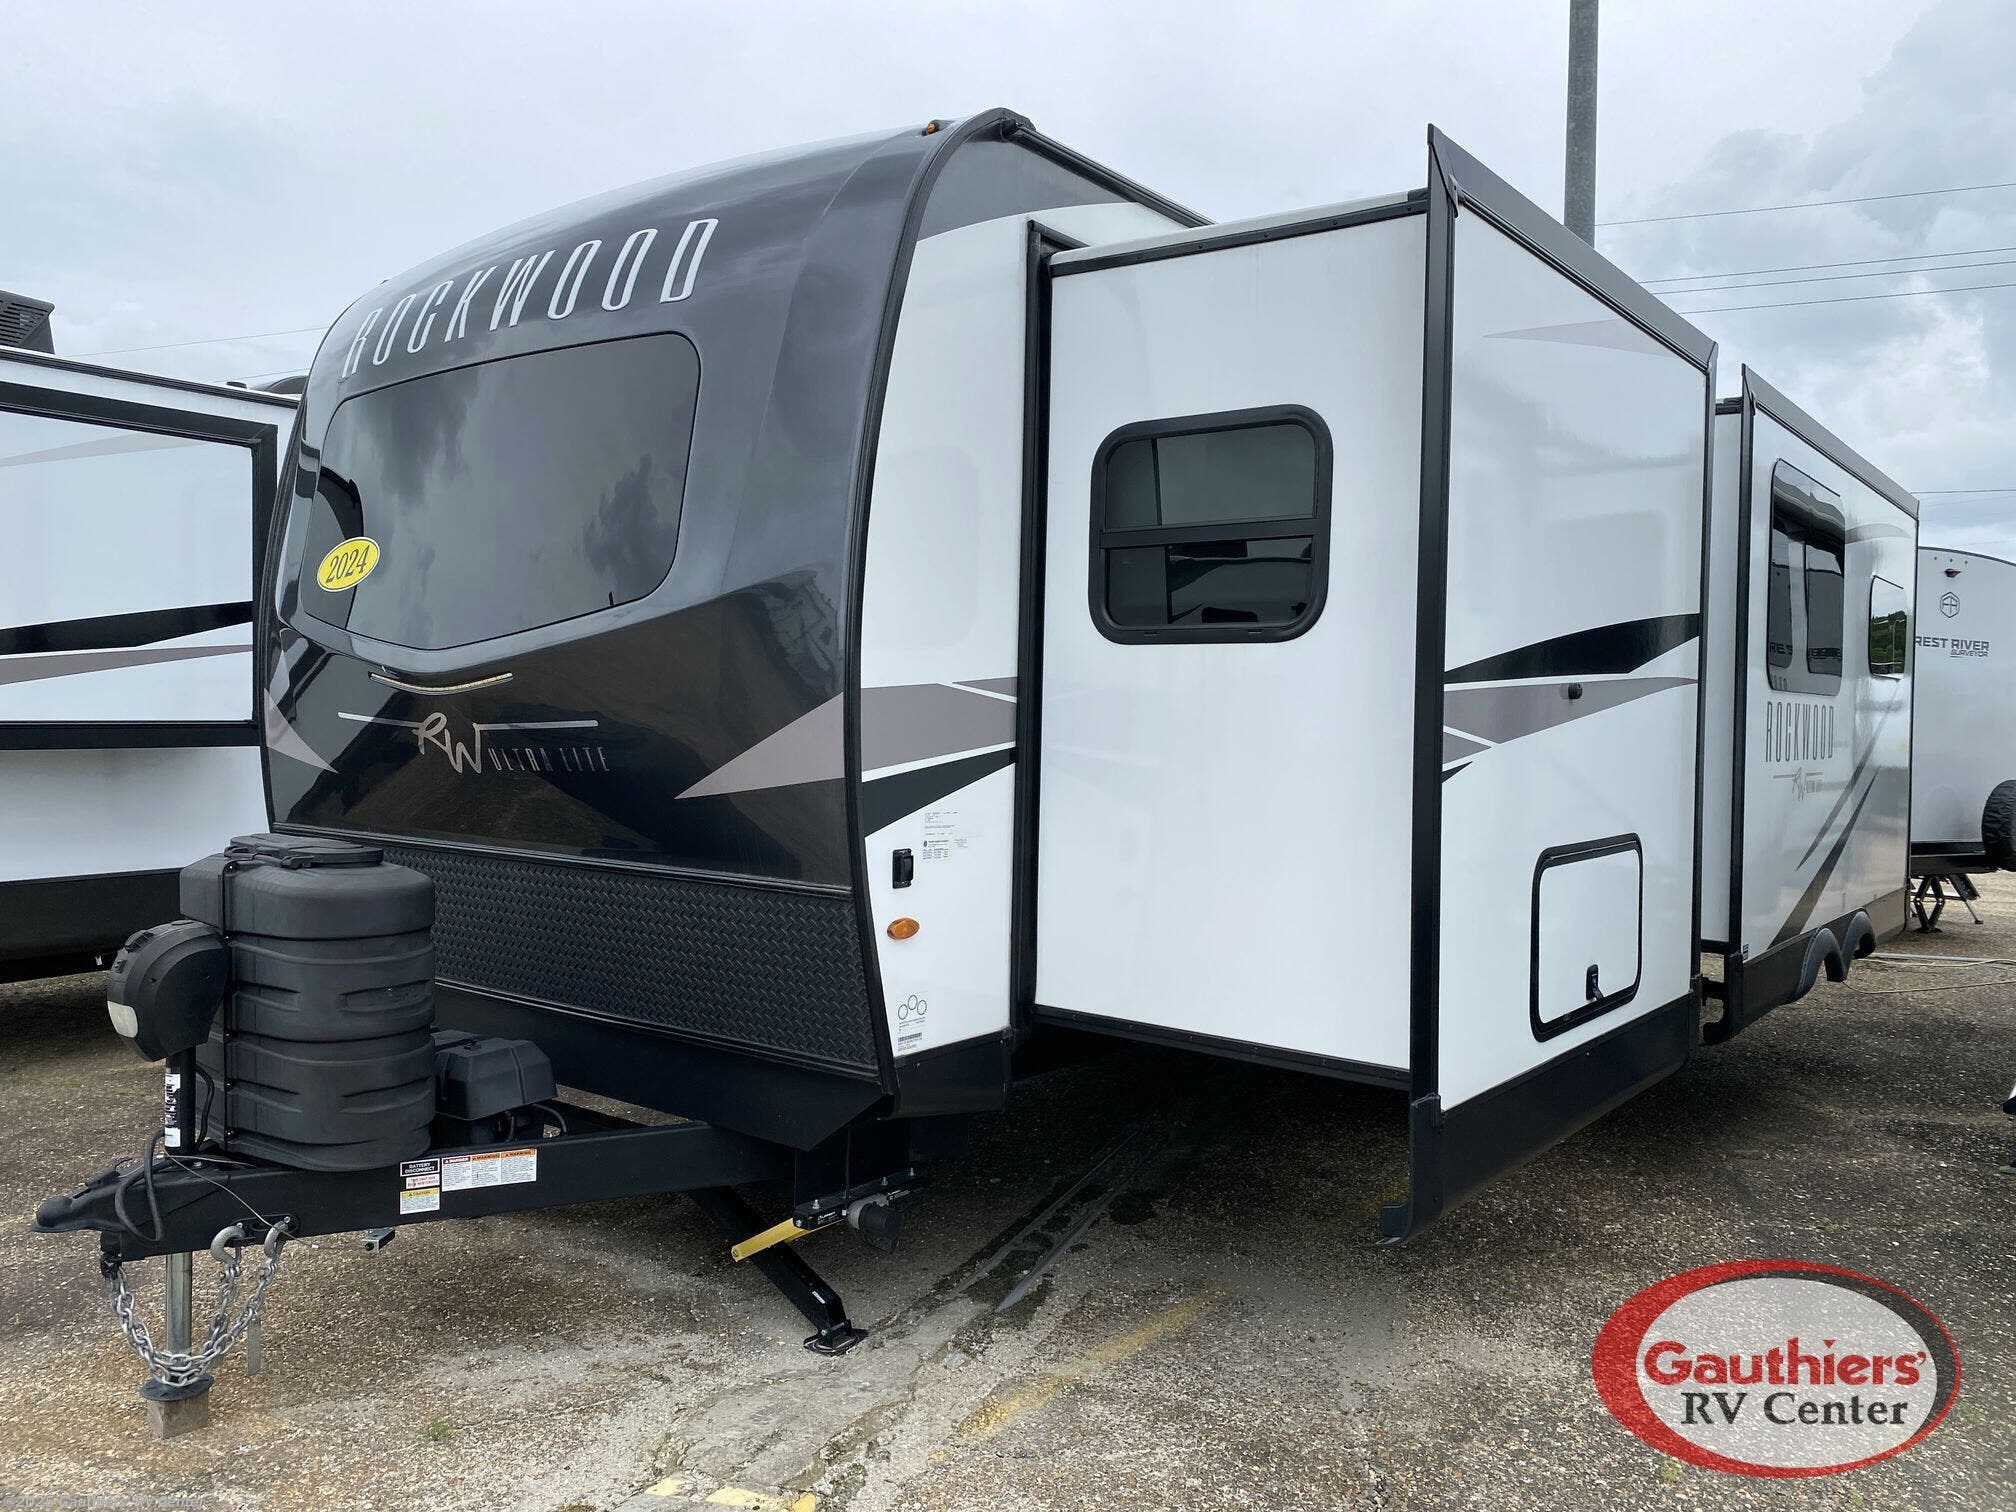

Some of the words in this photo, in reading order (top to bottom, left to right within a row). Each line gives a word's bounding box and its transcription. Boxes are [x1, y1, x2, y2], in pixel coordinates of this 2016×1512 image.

[340, 218, 719, 380] ROCKWOOD
[325, 545, 371, 583] 2024
[1951, 639, 1990, 651] RIVER
[1951, 649, 1988, 657] SURVEYOR
[411, 712, 482, 774] RW
[1766, 701, 1834, 762] ROCKWOOD
[487, 748, 553, 771] ULTRA
[559, 747, 610, 771] LITE
[404, 1166, 435, 1174] DISCONNECT
